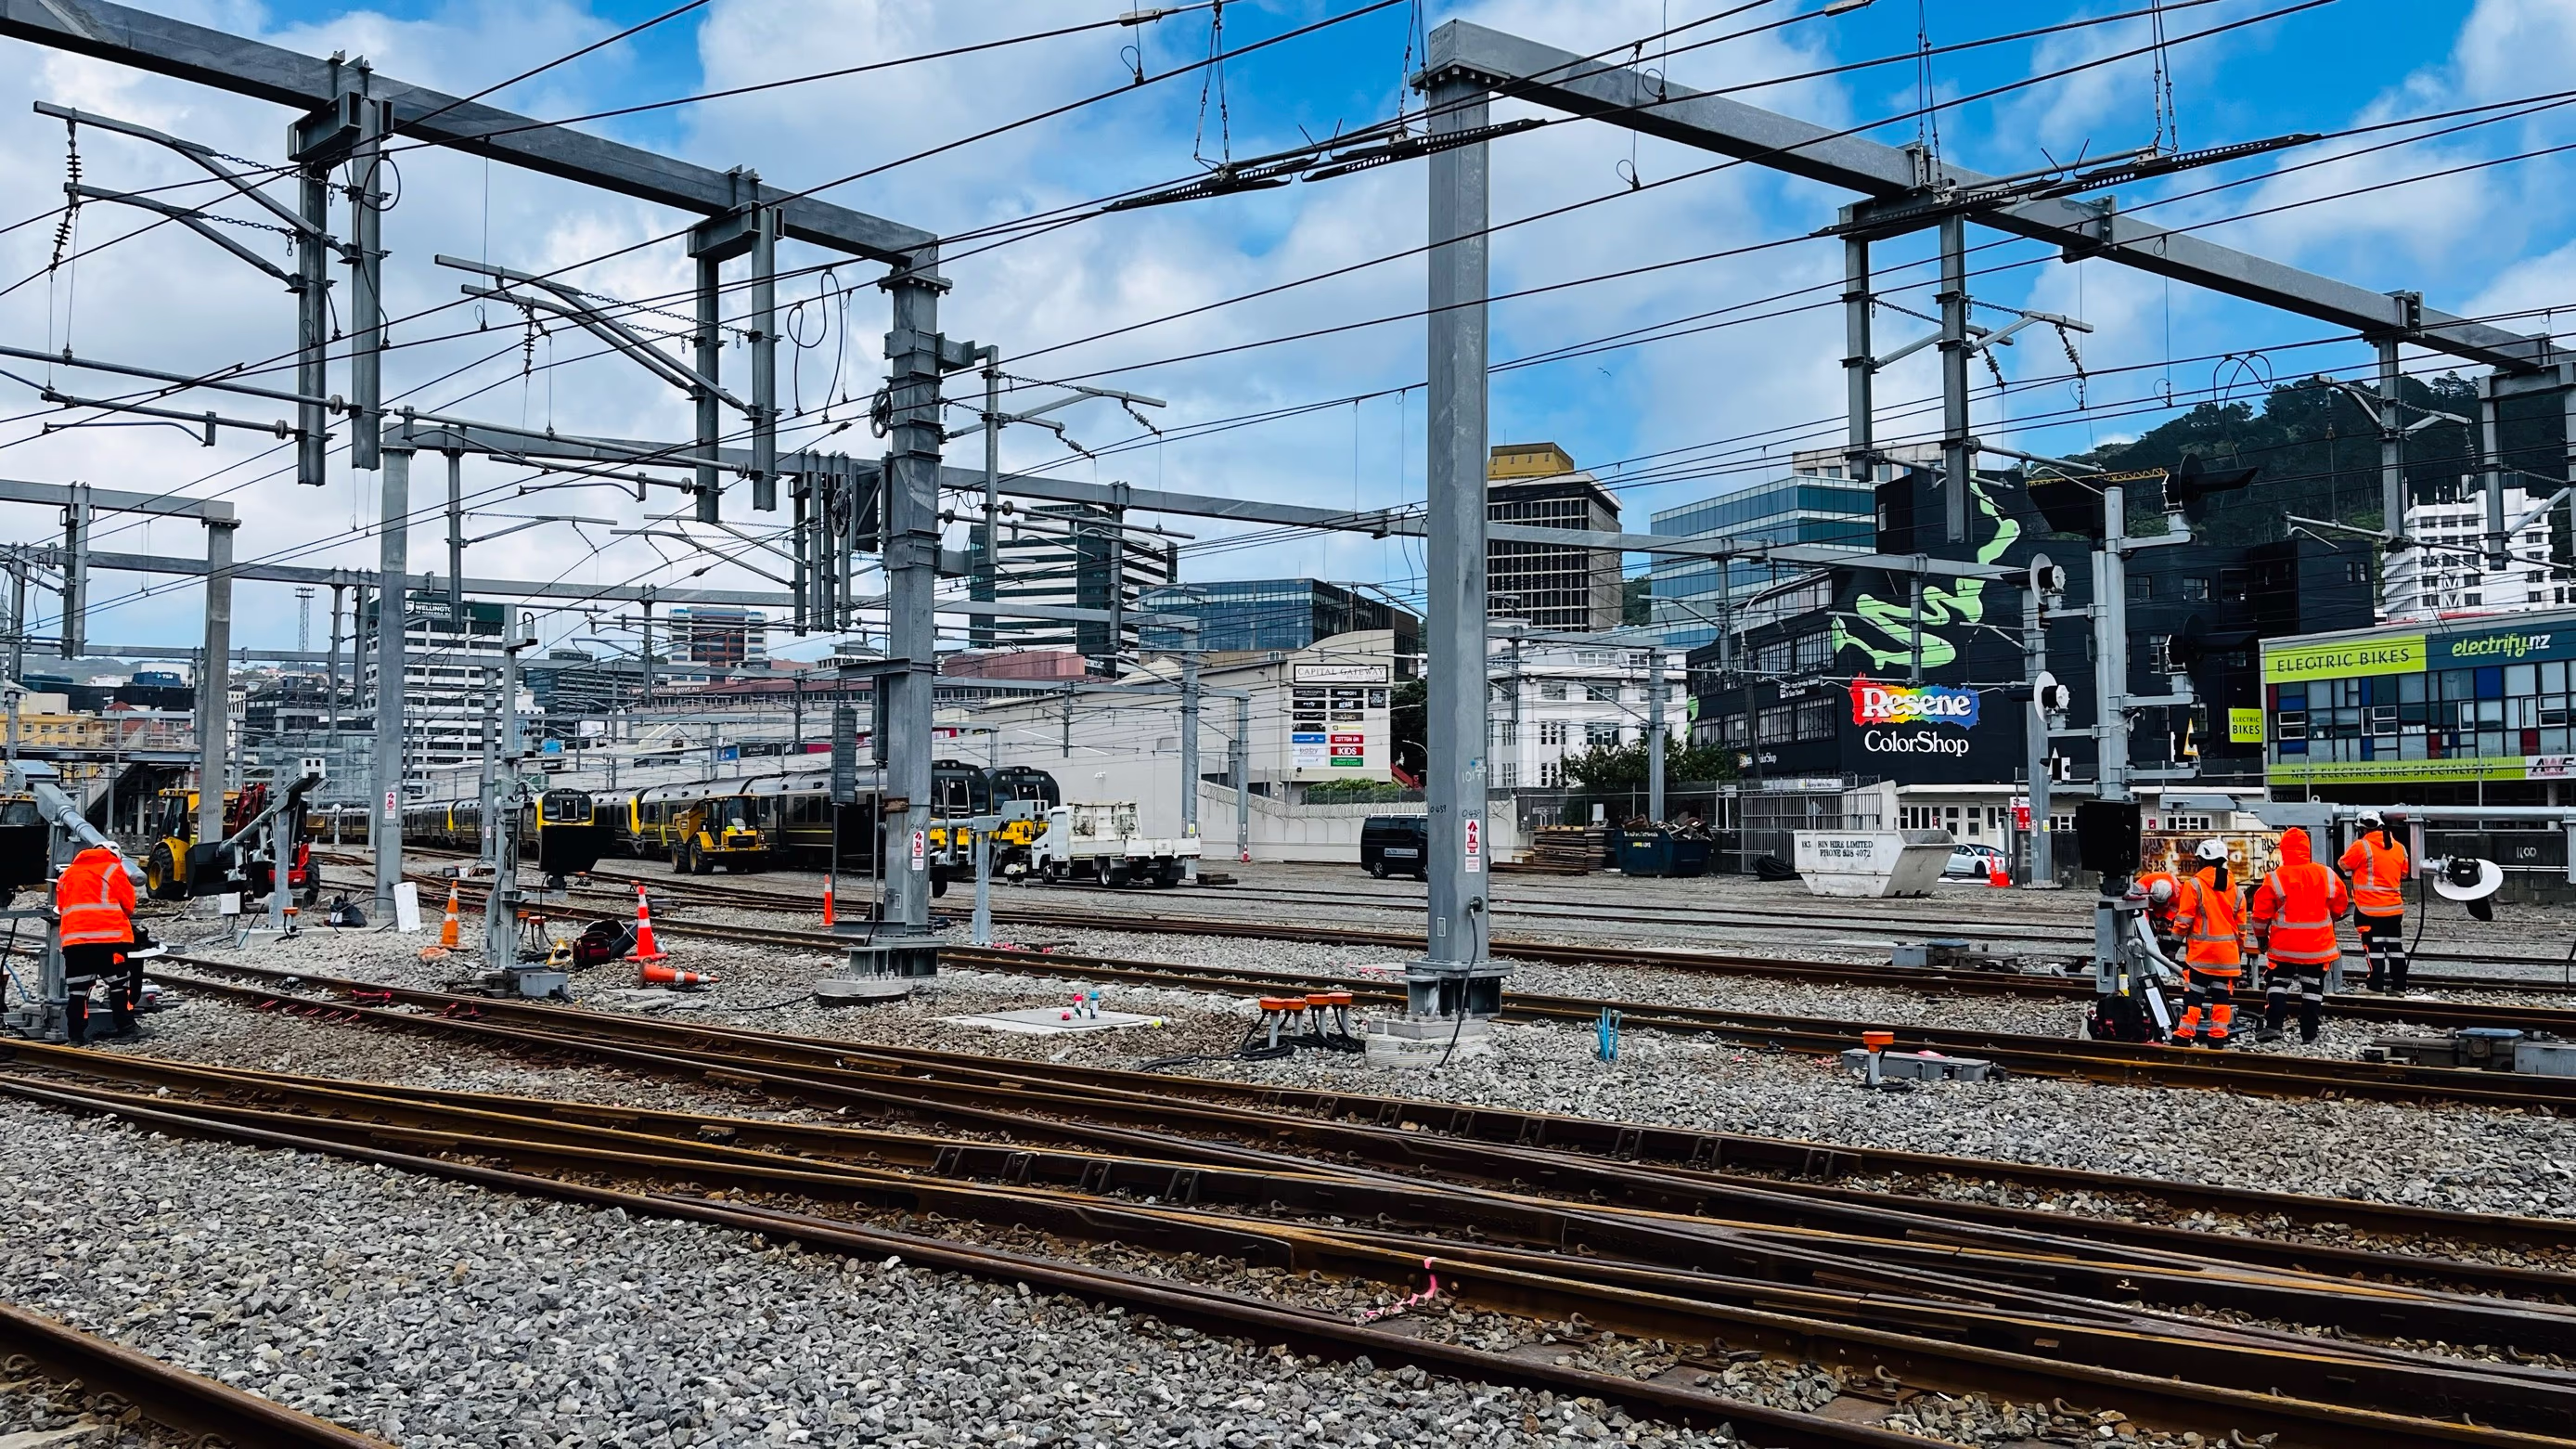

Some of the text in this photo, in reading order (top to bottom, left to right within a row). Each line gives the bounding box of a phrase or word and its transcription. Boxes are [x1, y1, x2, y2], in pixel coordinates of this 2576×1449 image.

[2277, 648, 2411, 673] ELECTRIC BIKES
[1297, 667, 1385, 676] CAPITAL GATEWAY
[1861, 688, 1971, 718] Resene
[2232, 724, 2260, 735] BIKES
[1864, 730, 1969, 757] ColorShop
[1758, 752, 1777, 764] olorShop
[2531, 757, 2575, 773] AWF
[2291, 769, 2315, 779] NZS
[1818, 840, 1828, 848] BIN
[1829, 840, 1845, 848] HIRE
[1846, 840, 1874, 848] LIMITED
[1856, 849, 1872, 858] 4072
